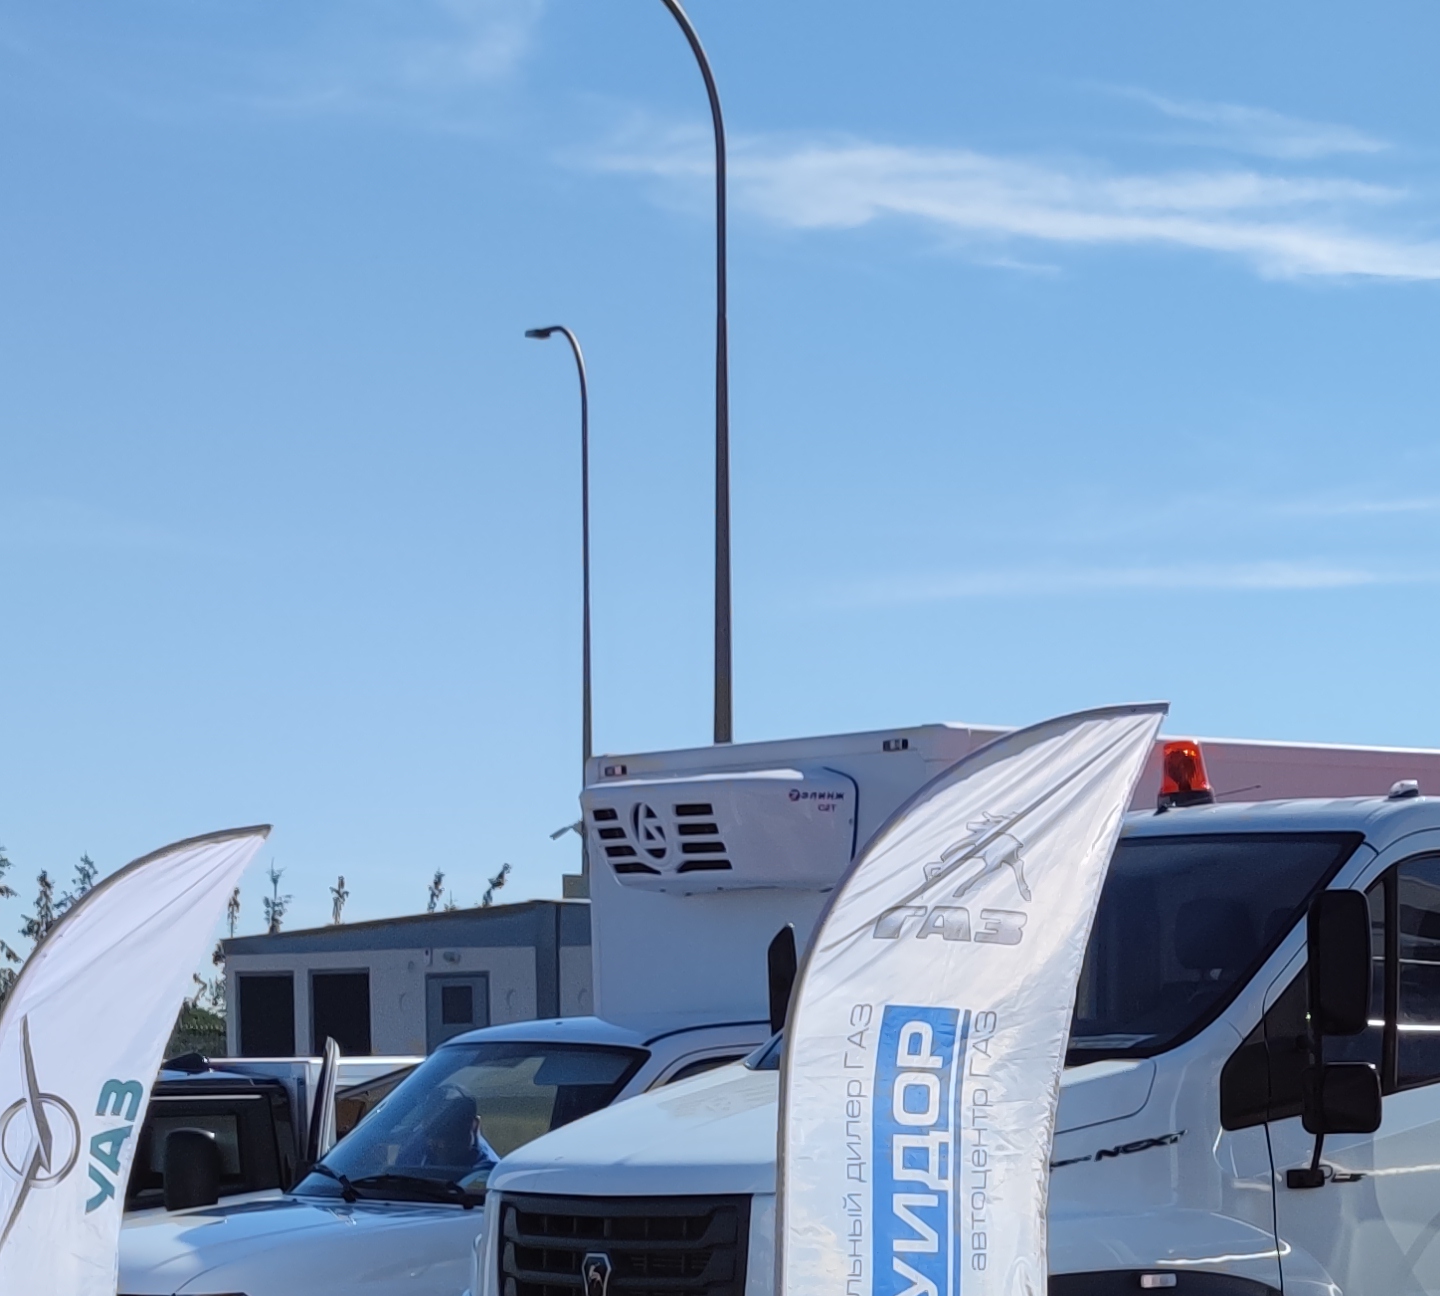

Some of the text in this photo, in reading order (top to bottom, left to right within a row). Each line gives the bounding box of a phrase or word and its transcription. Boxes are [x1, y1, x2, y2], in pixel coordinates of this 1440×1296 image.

[872, 904, 1029, 946] ГАЗ
[843, 1003, 873, 1070] ГАЗ
[84, 1078, 144, 1215] УАЗ
[844, 1079, 868, 1184] дилер
[968, 1010, 998, 1272] автоцентр ГАЗ
